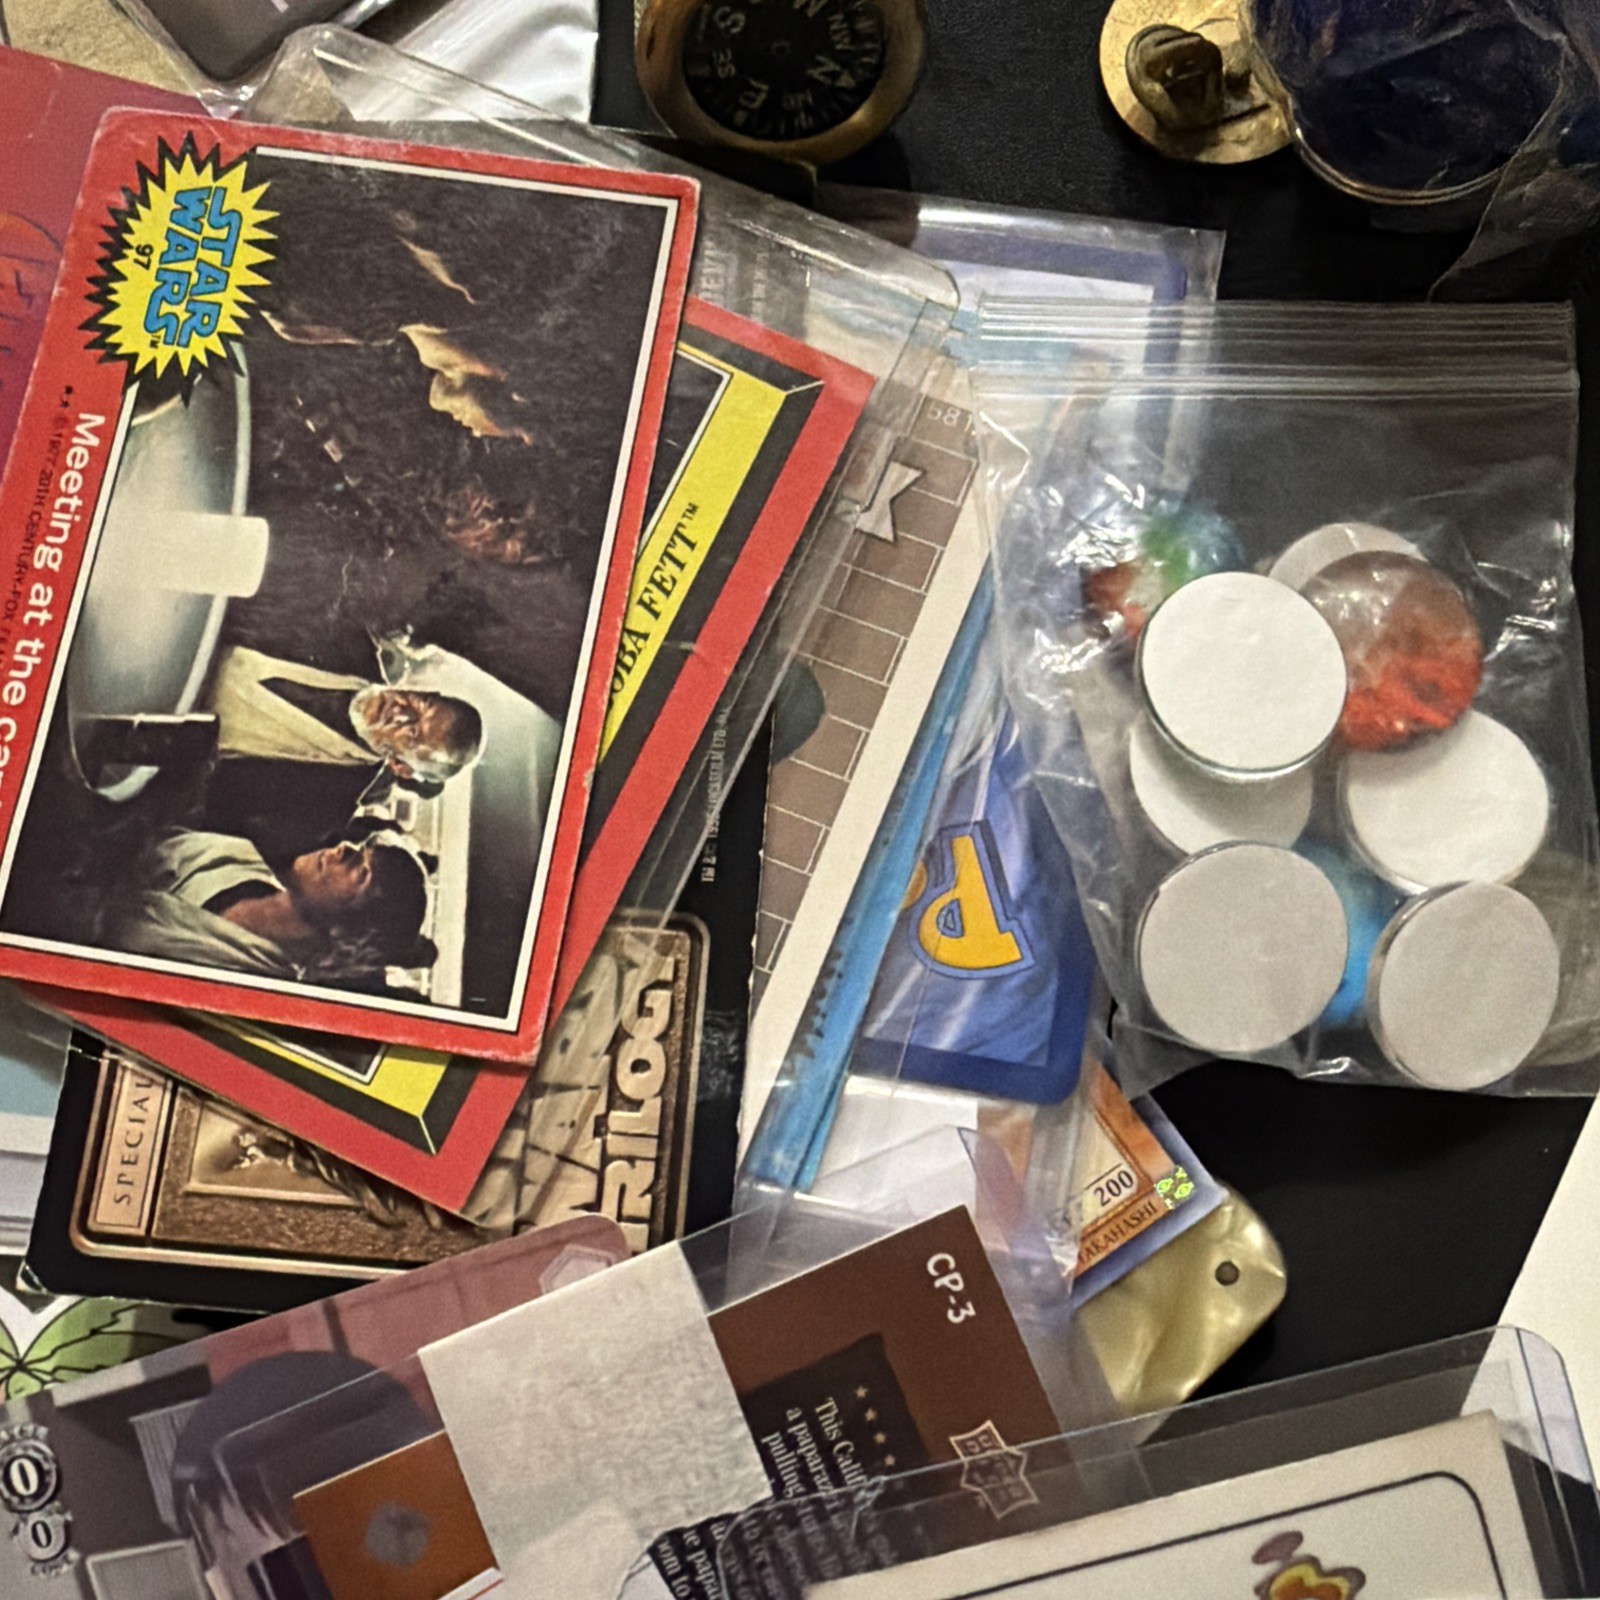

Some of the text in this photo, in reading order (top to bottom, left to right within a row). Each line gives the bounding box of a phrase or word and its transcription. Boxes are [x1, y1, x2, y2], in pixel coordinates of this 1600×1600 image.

[133, 243, 155, 271] 97
[143, 186, 213, 346] WARS
[177, 186, 242, 348] STAR
[33, 412, 106, 573] Meeting
[23, 582, 54, 627] at
[599, 627, 651, 712] OBA
[636, 521, 698, 621] FETT
[2, 638, 45, 706] the
[114, 1077, 152, 1206] SPECIAL
[1093, 1169, 1135, 1208] 200
[926, 1253, 977, 1324] CP-3
[786, 1407, 802, 1421] a
[815, 1396, 843, 1440] This
[761, 1431, 806, 1498] pulling
